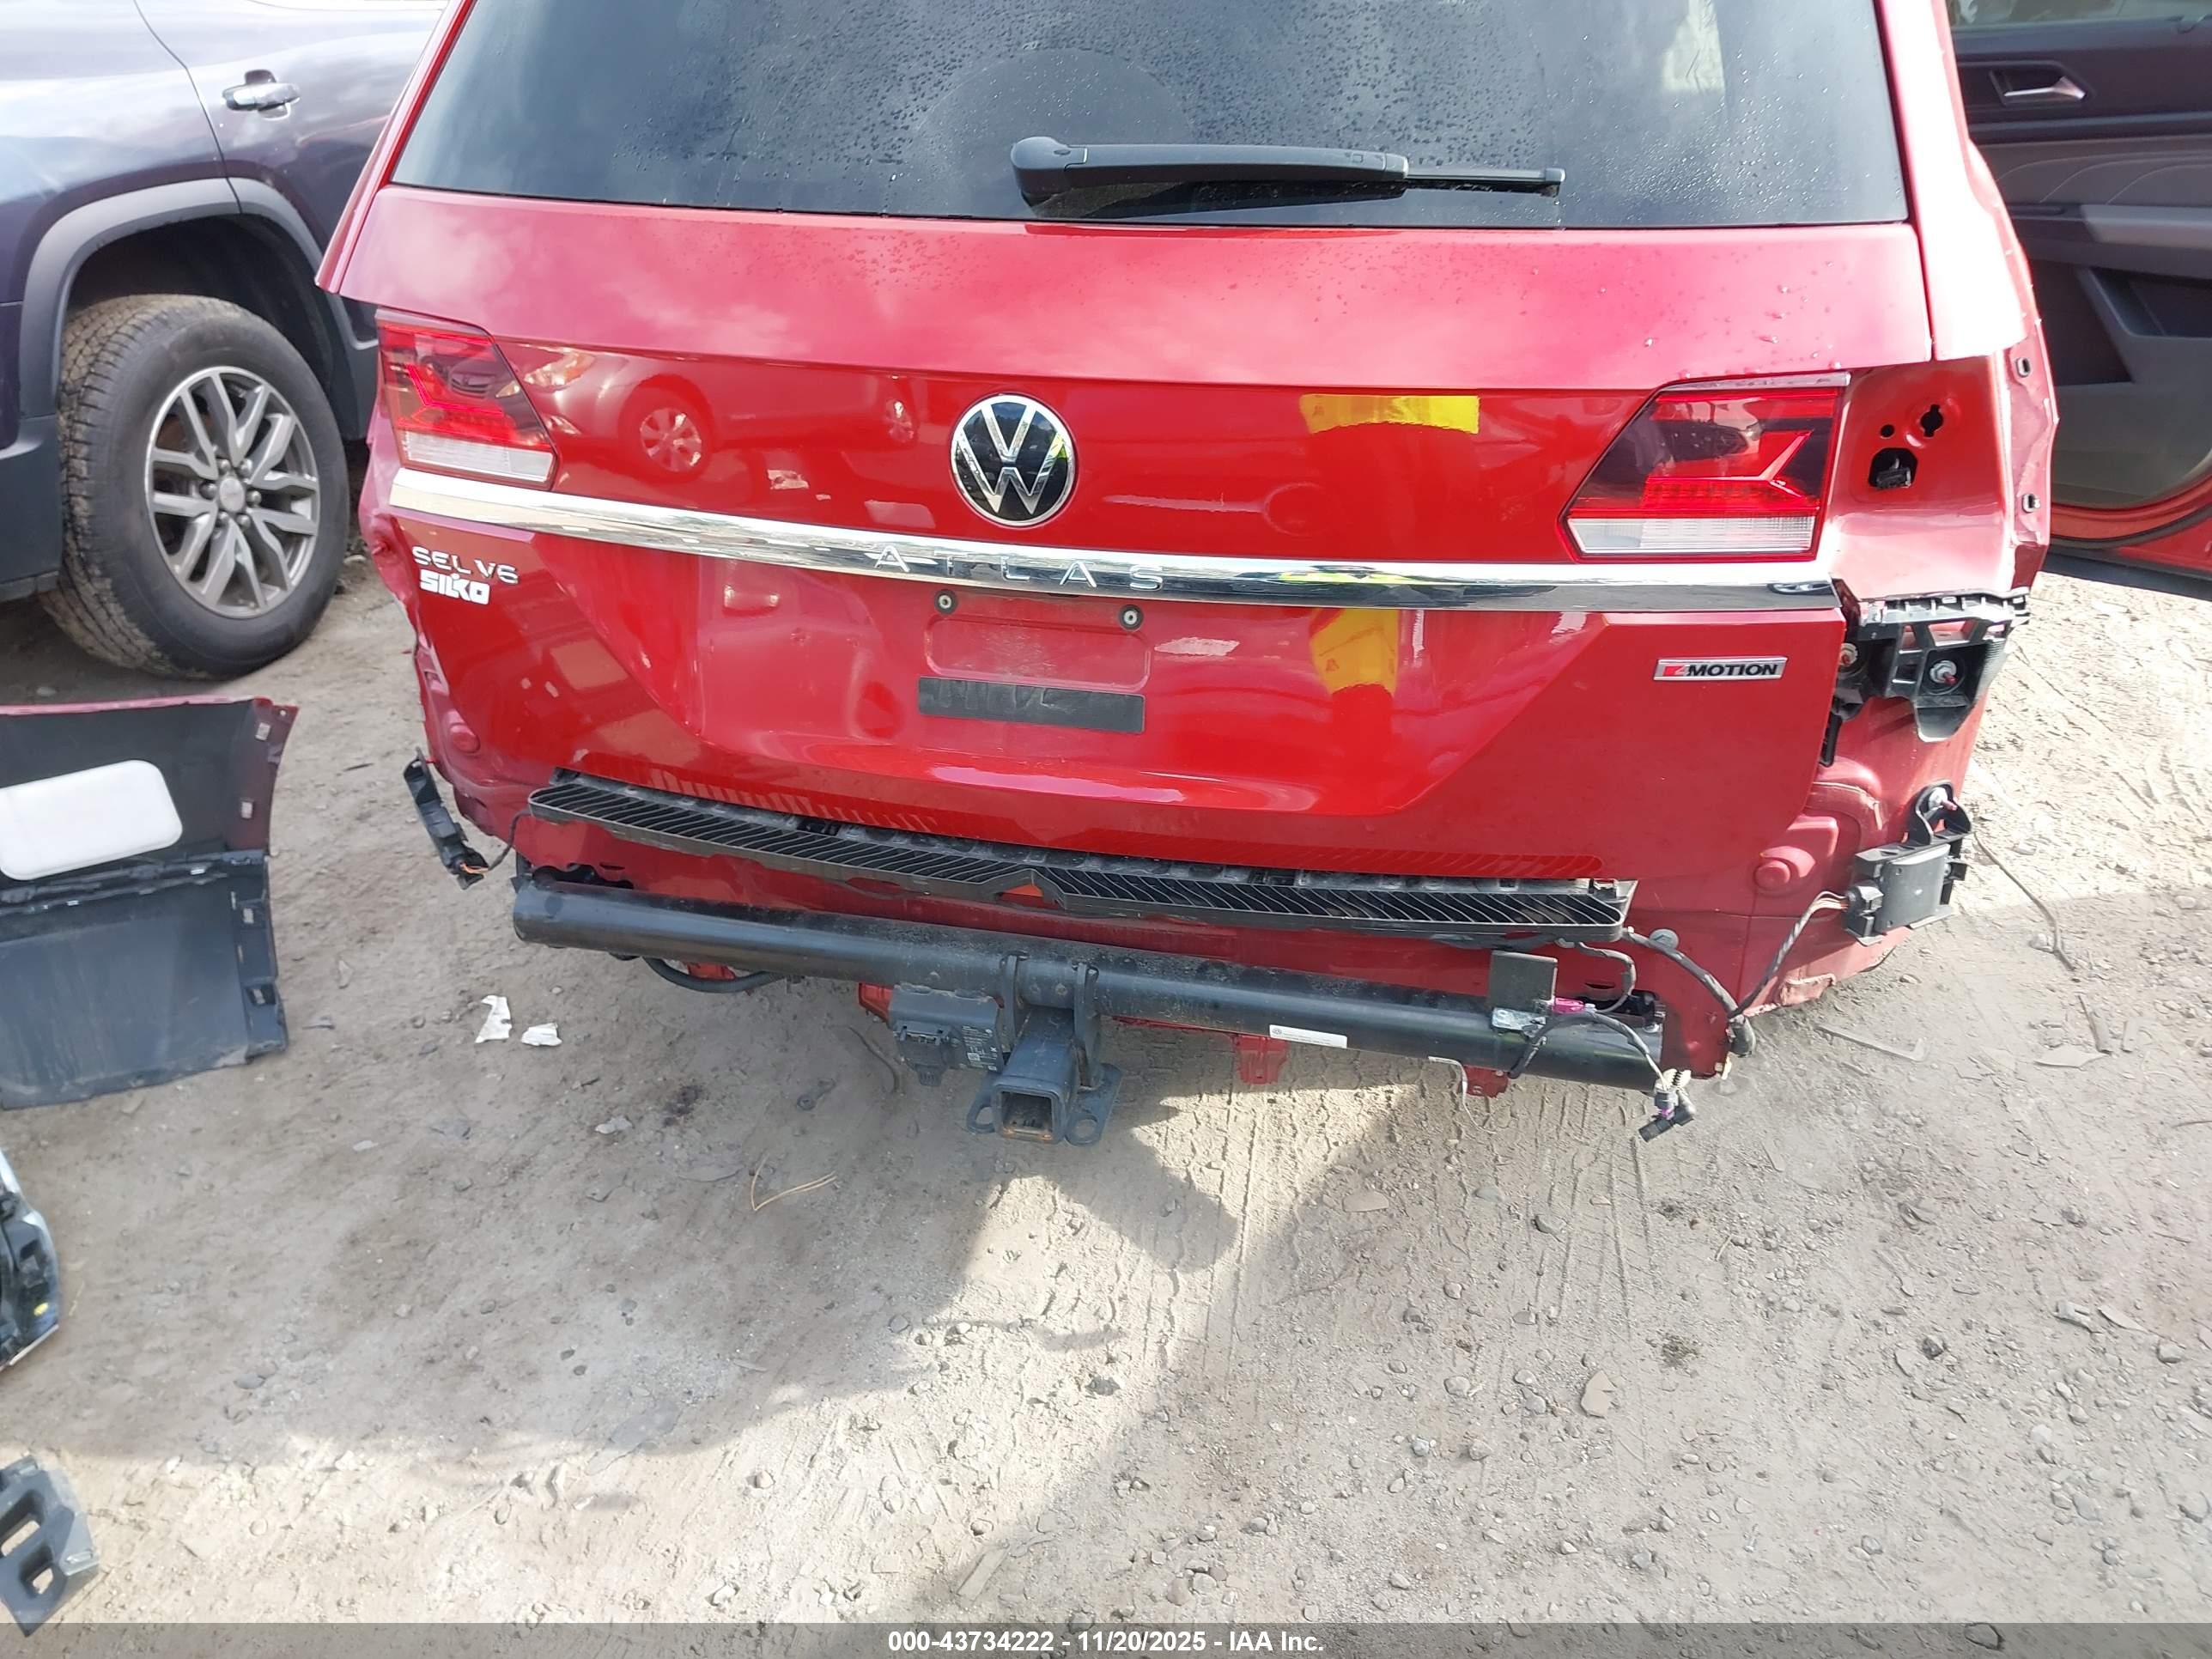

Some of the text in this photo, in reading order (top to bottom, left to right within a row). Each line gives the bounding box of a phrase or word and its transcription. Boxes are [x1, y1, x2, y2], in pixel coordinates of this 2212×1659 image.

[412, 545, 520, 585] SEL V6
[873, 544, 1164, 592] ATLAS
